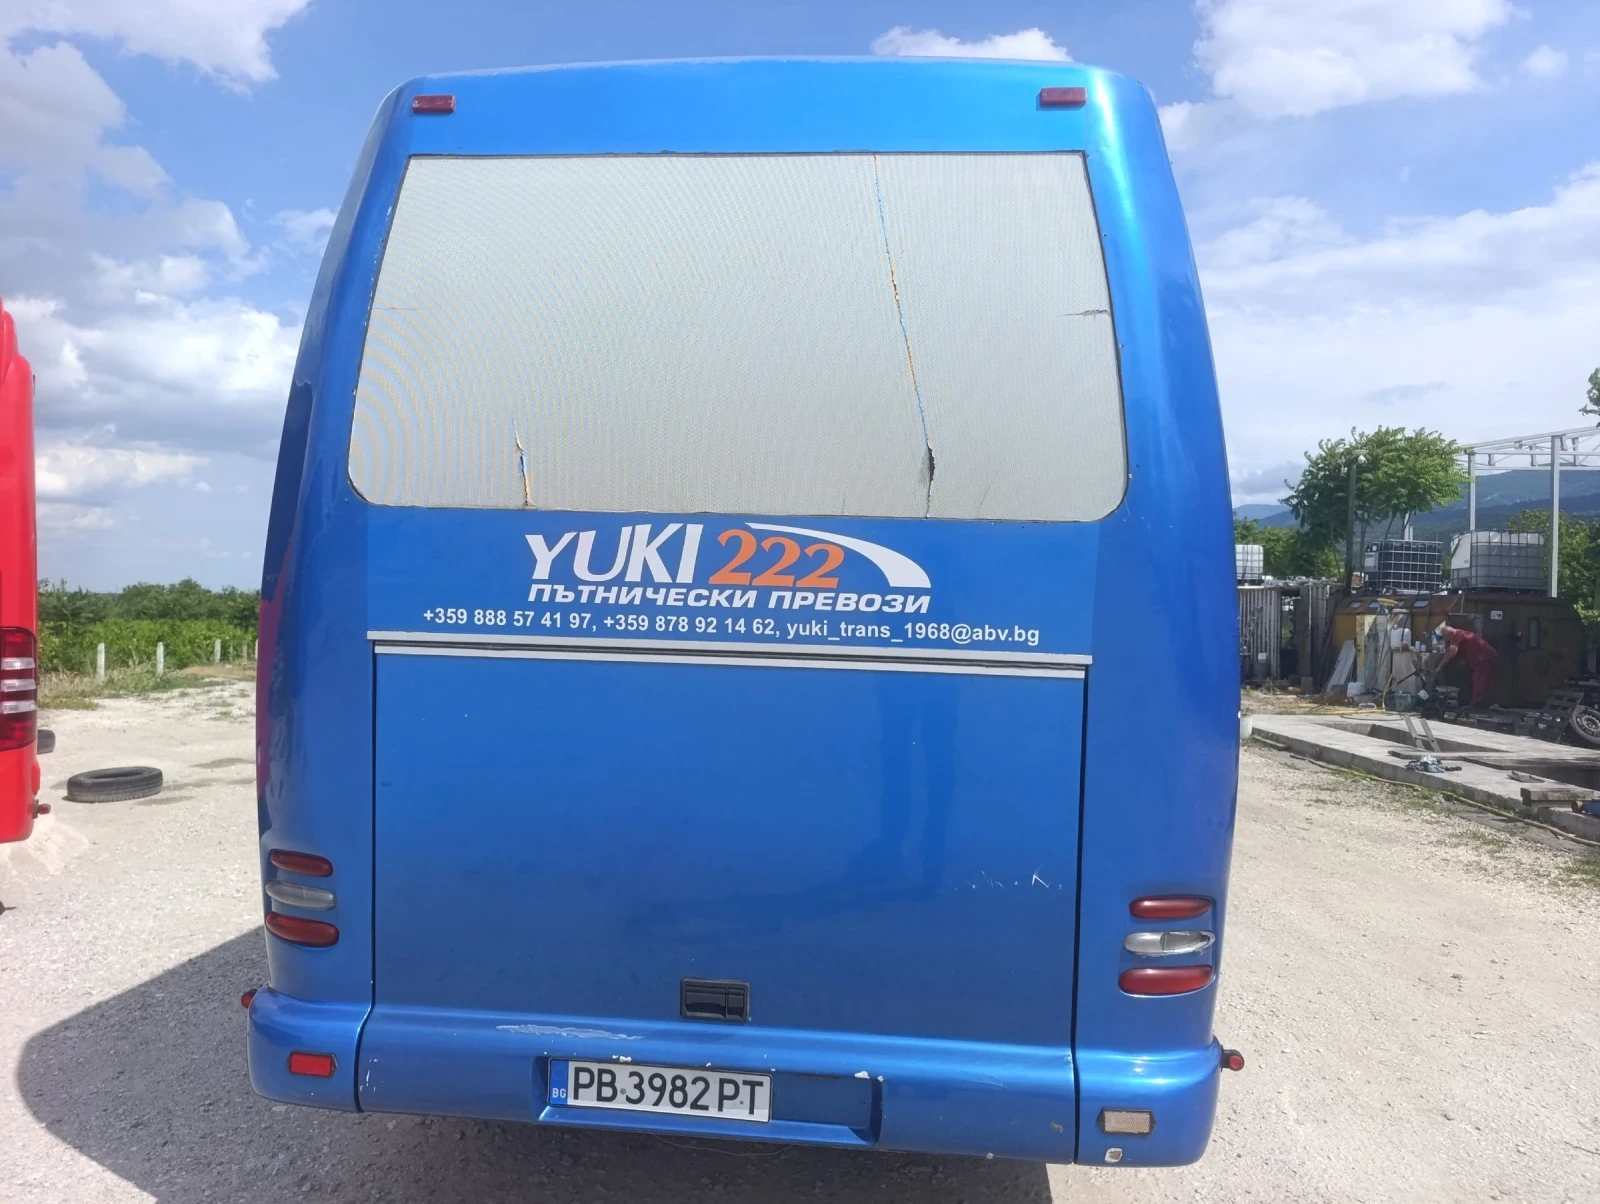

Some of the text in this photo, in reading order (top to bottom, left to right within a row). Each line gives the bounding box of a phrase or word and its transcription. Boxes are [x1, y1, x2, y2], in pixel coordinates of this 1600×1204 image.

[525, 522, 845, 589] YUKI 222
[528, 584, 931, 614] ПЪТНИЧЕСКИ ПРЕВОЗИ
[423, 608, 1040, 646] +359 888 57 41 97, +359 878 92 14 62, yuki_trans_1968@abv.bg
[552, 1087, 567, 1099] BG
[625, 1071, 710, 1111] 3982
